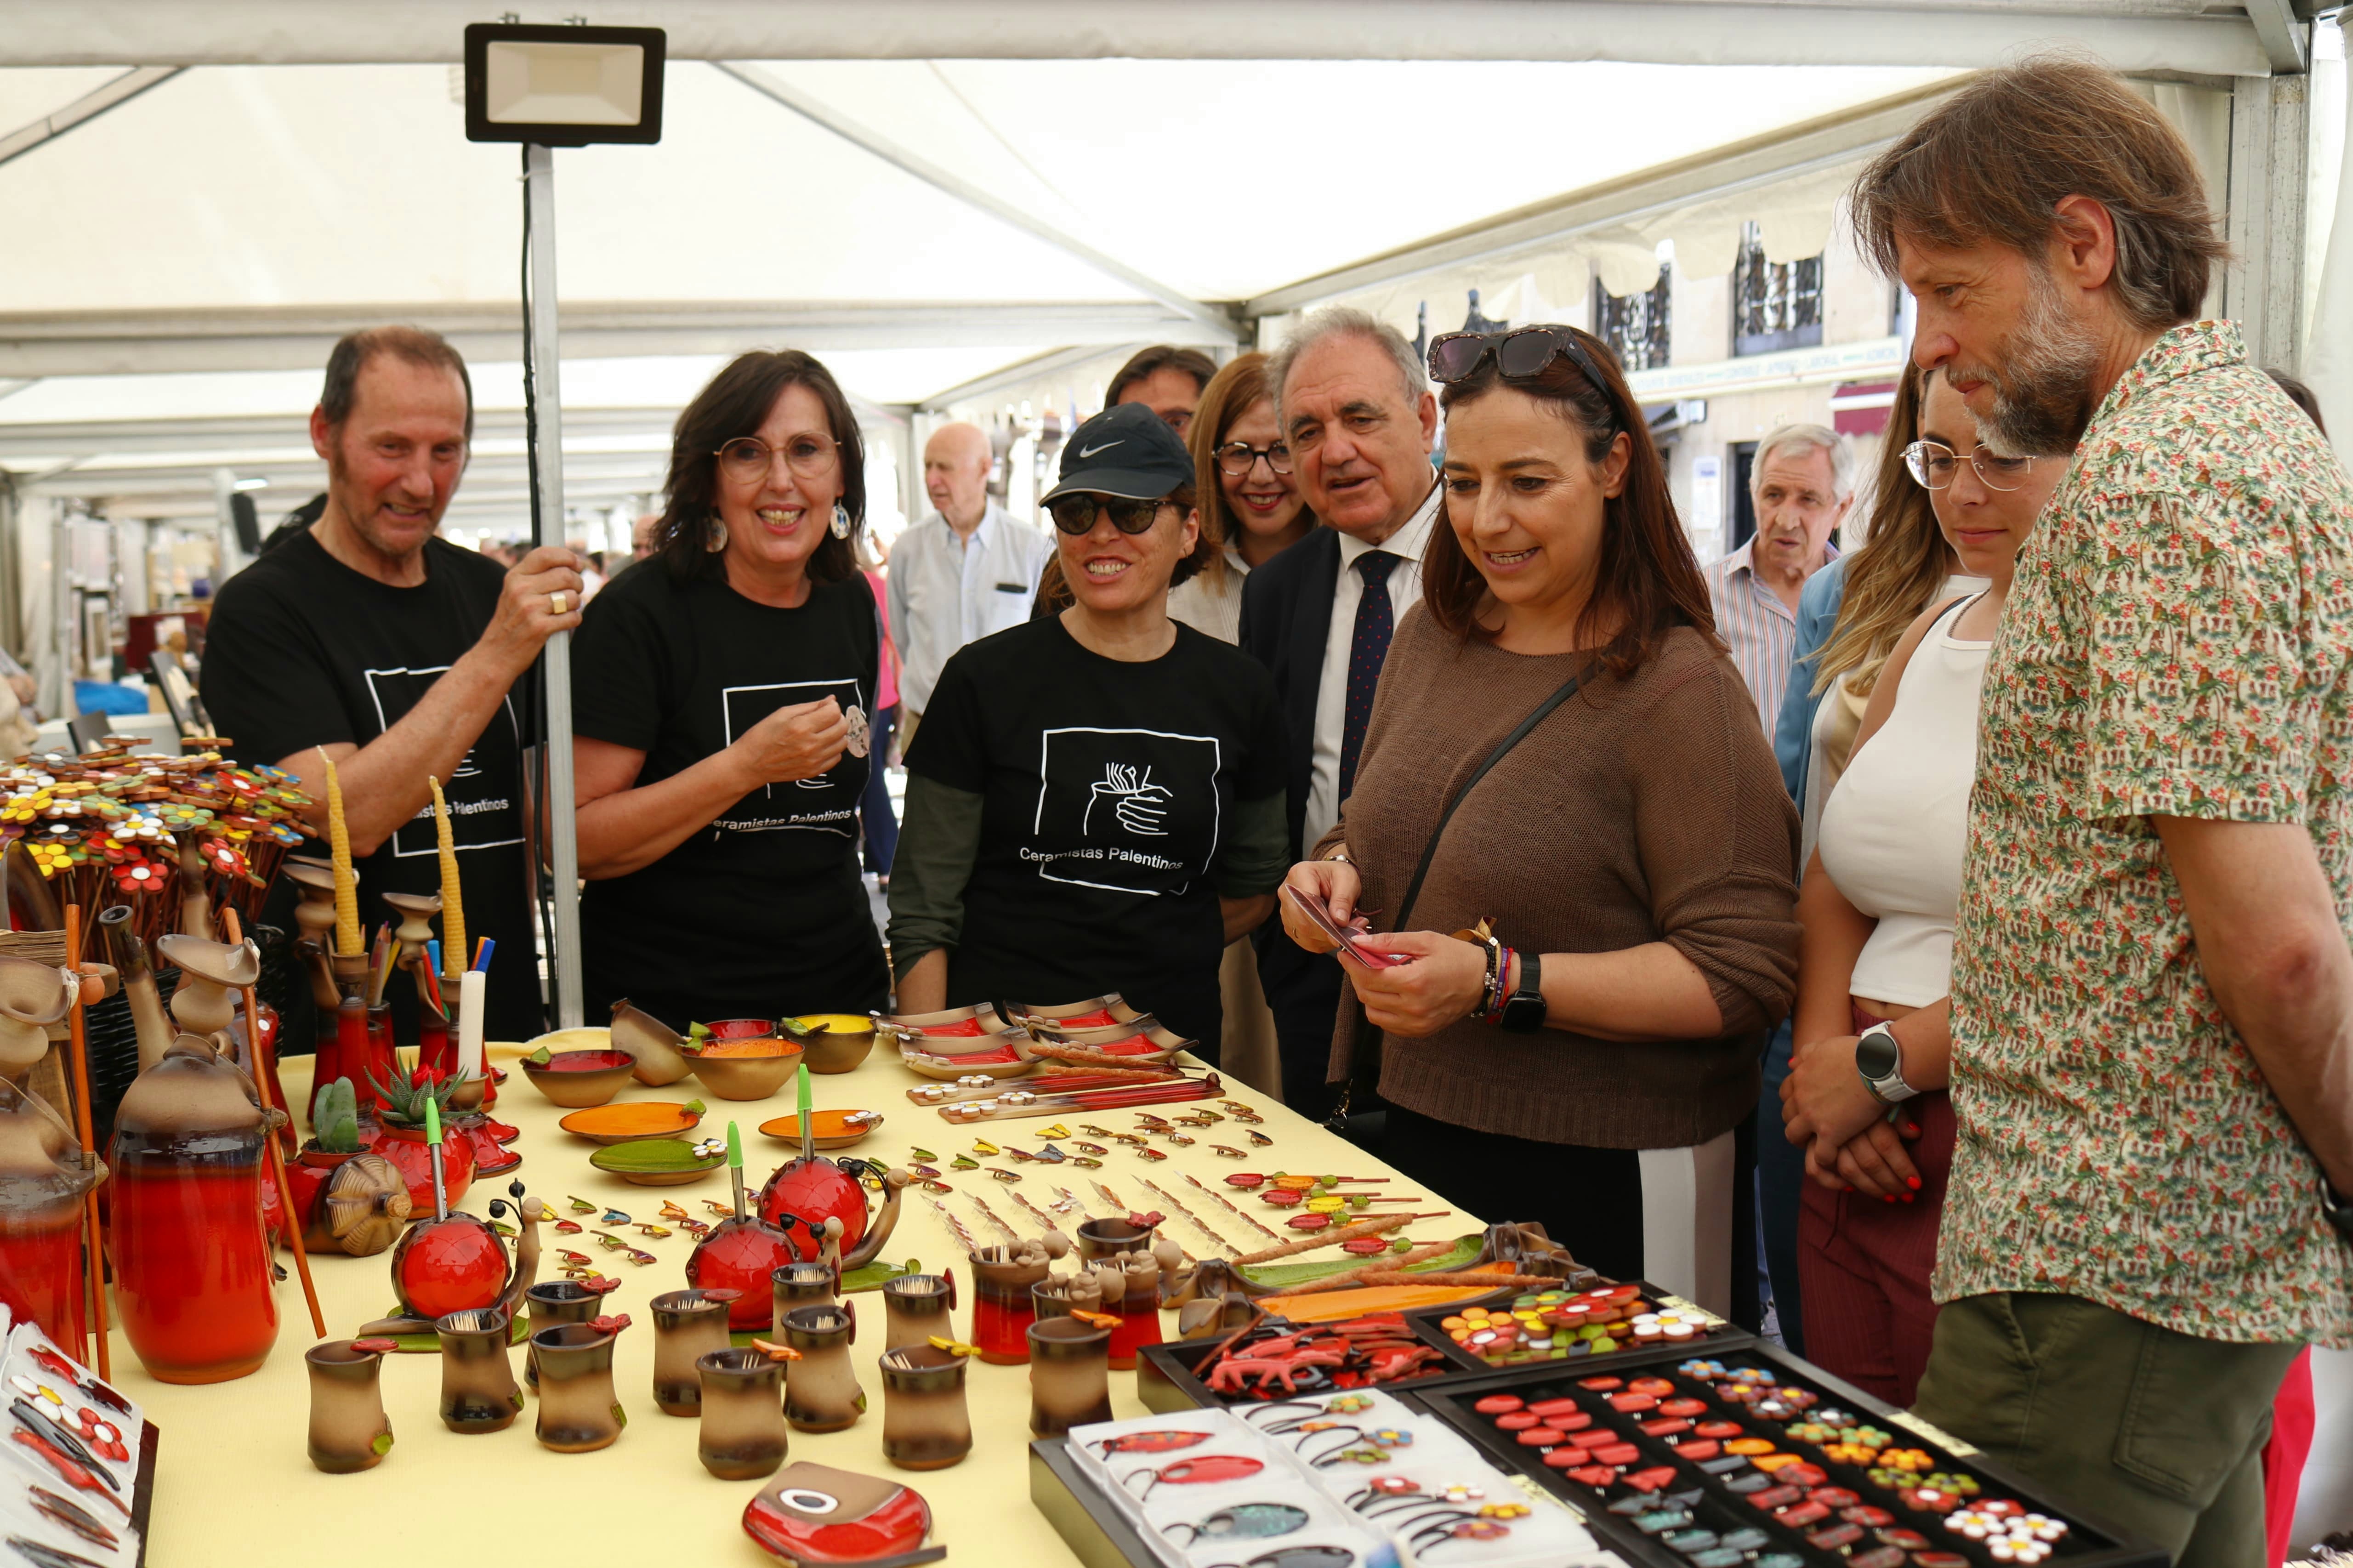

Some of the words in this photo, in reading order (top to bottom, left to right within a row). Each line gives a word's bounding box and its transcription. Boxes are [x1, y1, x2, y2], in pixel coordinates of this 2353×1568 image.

[710, 818, 784, 829] eramistas
[788, 810, 852, 824] Palentinos
[1020, 847, 1103, 862] Ceramistas
[1108, 847, 1183, 869] Palentinos
